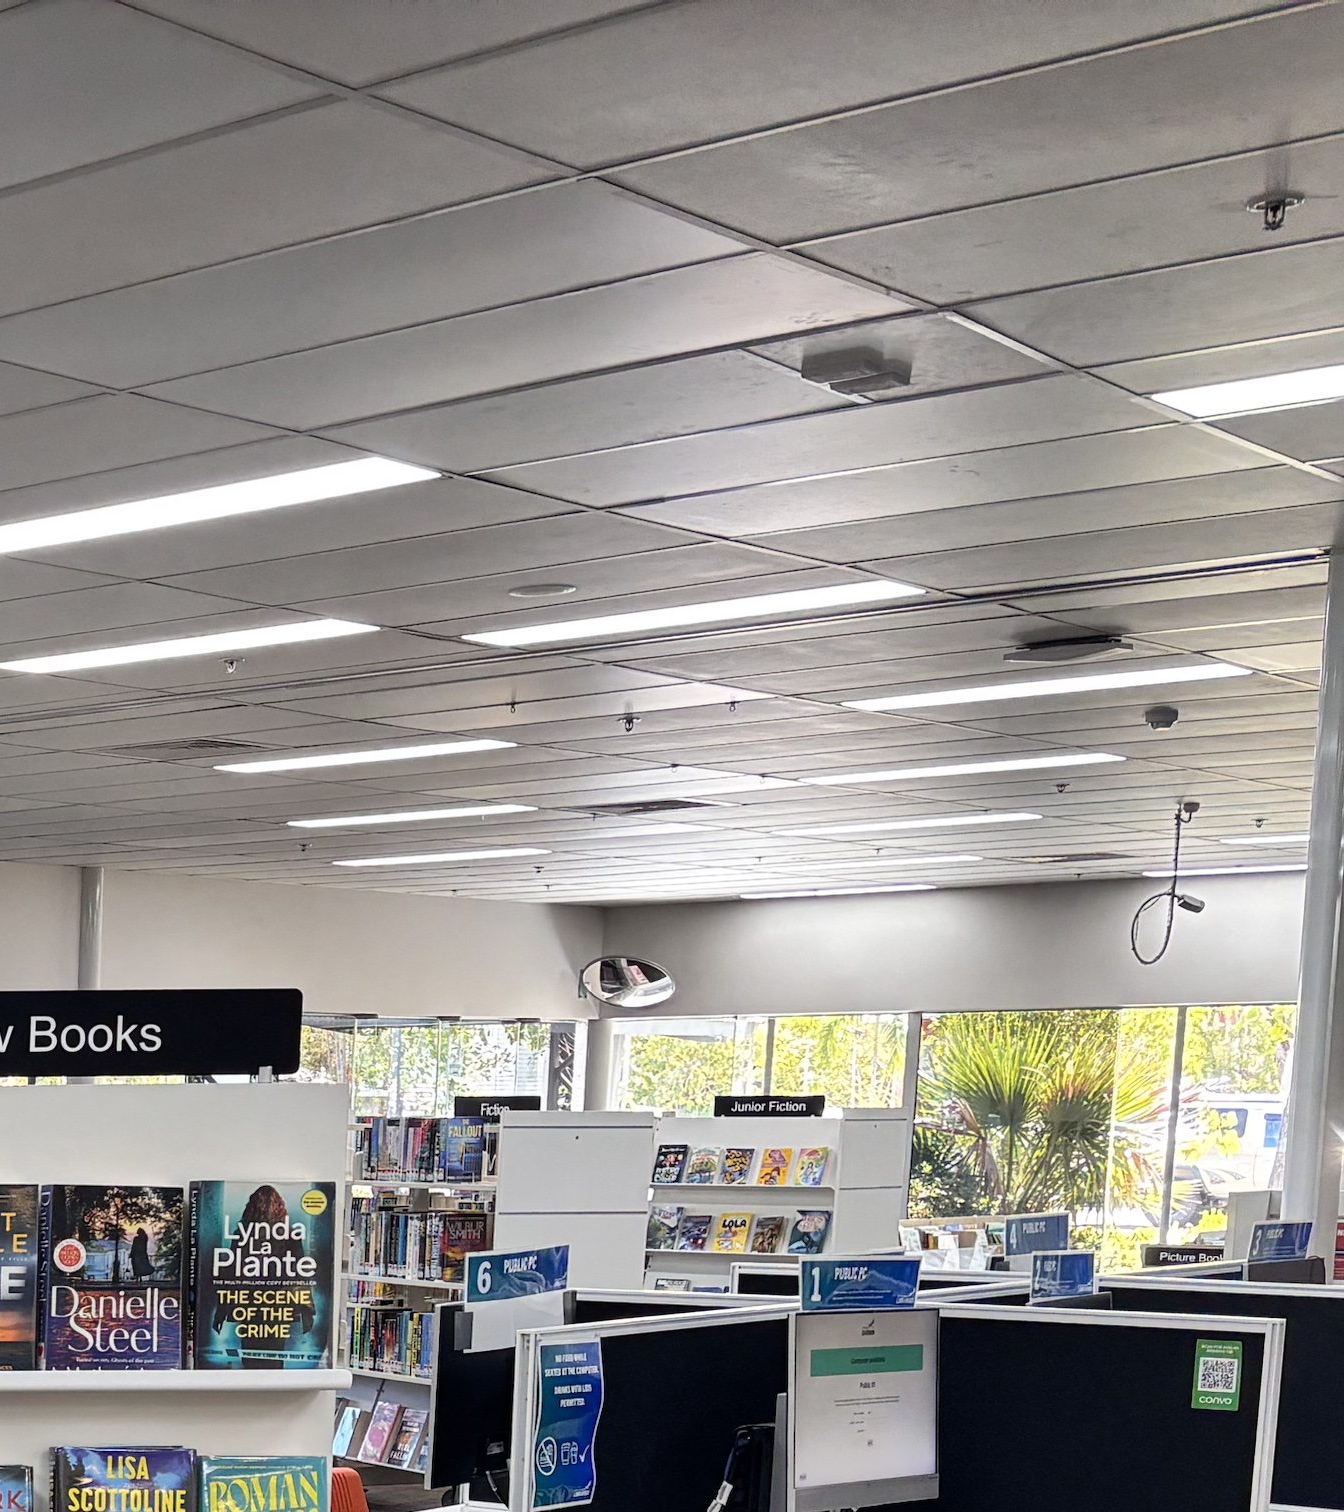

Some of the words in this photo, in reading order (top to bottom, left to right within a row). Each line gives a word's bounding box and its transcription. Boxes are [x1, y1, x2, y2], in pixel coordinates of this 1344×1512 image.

[29, 1015, 162, 1053] Books
[481, 1103, 510, 1116] Fiction
[731, 1101, 766, 1112] Junior
[769, 1101, 806, 1112] Fiction
[448, 1125, 482, 1138] FALLOUT
[223, 1215, 306, 1247] Lynda
[722, 1219, 747, 1228] LOLA
[450, 1229, 481, 1239] SMITH
[1010, 1223, 1017, 1249] 4
[213, 1248, 317, 1278] Plante
[504, 1257, 528, 1273] PUBLIC
[1159, 1252, 1196, 1262] Picture
[477, 1261, 491, 1294] 6
[834, 1267, 858, 1280] PUBLIC
[811, 1267, 821, 1301] 1
[51, 1285, 179, 1319] Danielle
[68, 1312, 158, 1353] Steel
[1199, 1396, 1232, 1405] convo
[106, 1456, 150, 1480] LISA
